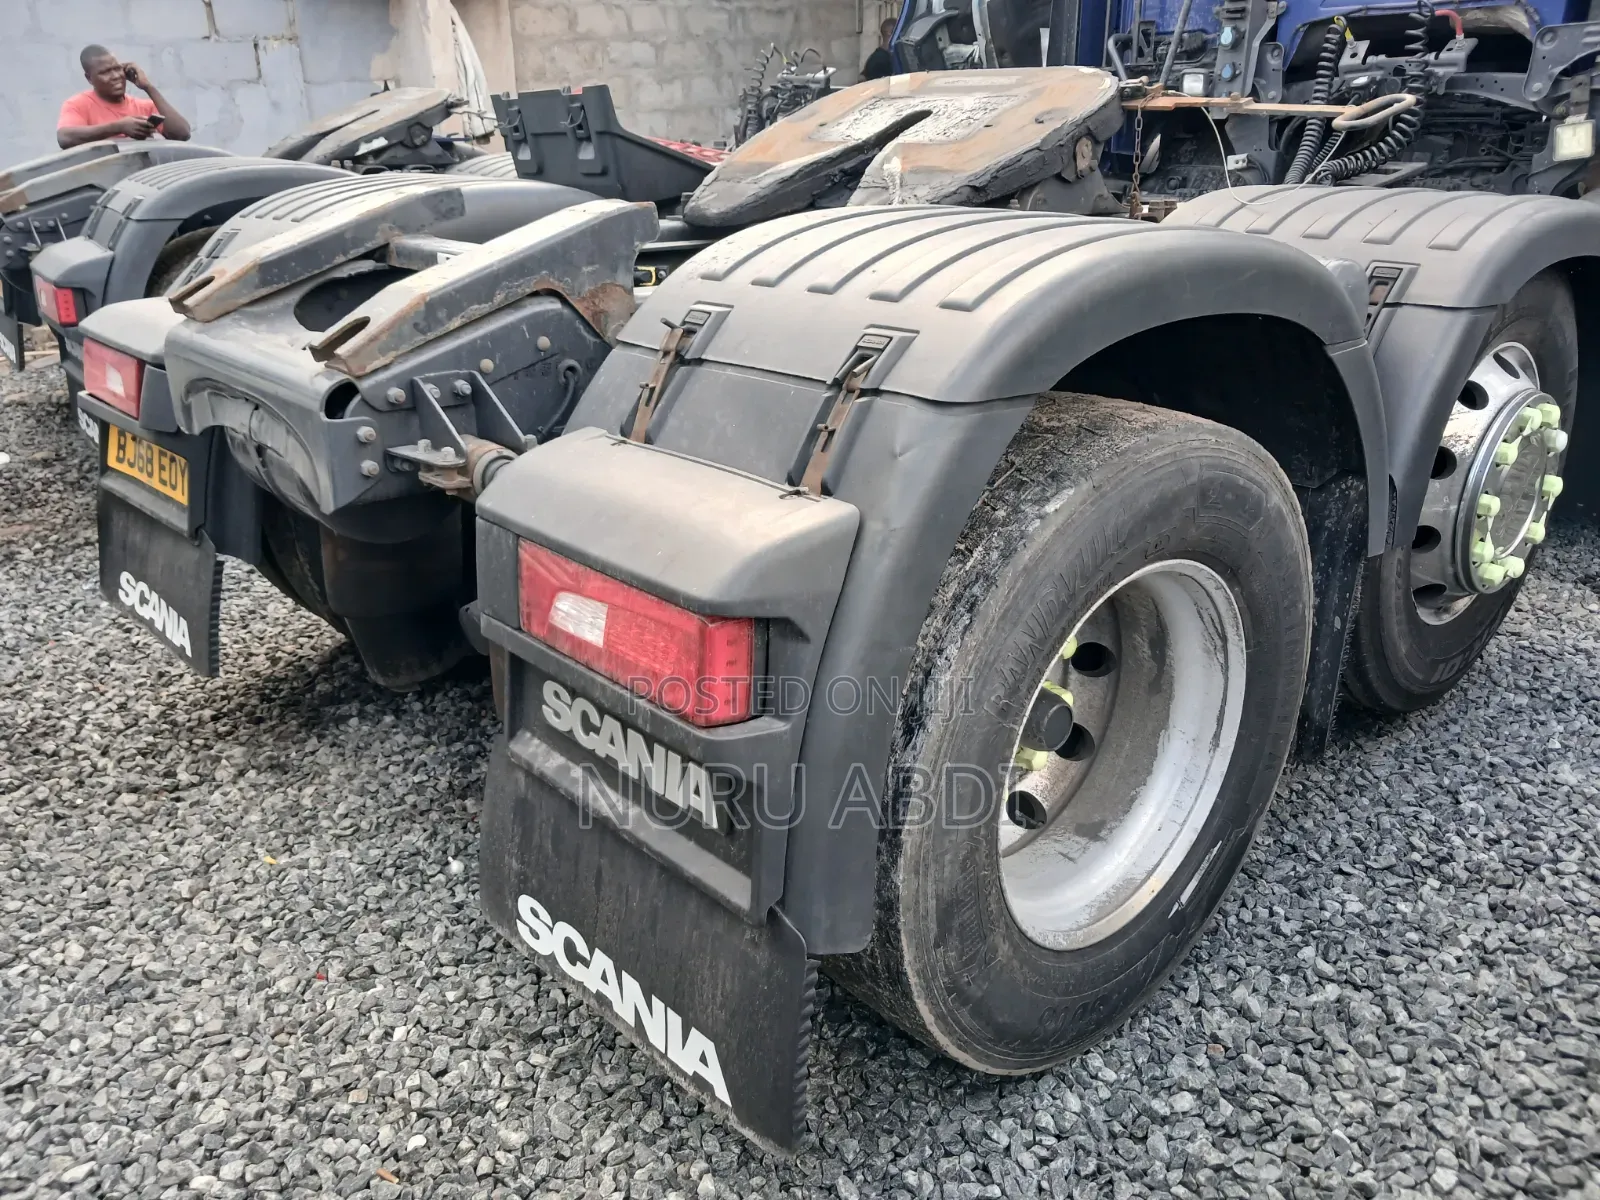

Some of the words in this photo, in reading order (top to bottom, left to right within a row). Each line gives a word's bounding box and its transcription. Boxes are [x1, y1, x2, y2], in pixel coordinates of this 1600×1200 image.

[116, 429, 155, 479] BJ68
[158, 449, 189, 497] EOY
[118, 571, 192, 658] SCANIA
[542, 680, 719, 829] SCANIA
[515, 894, 733, 1108] SCANIA
